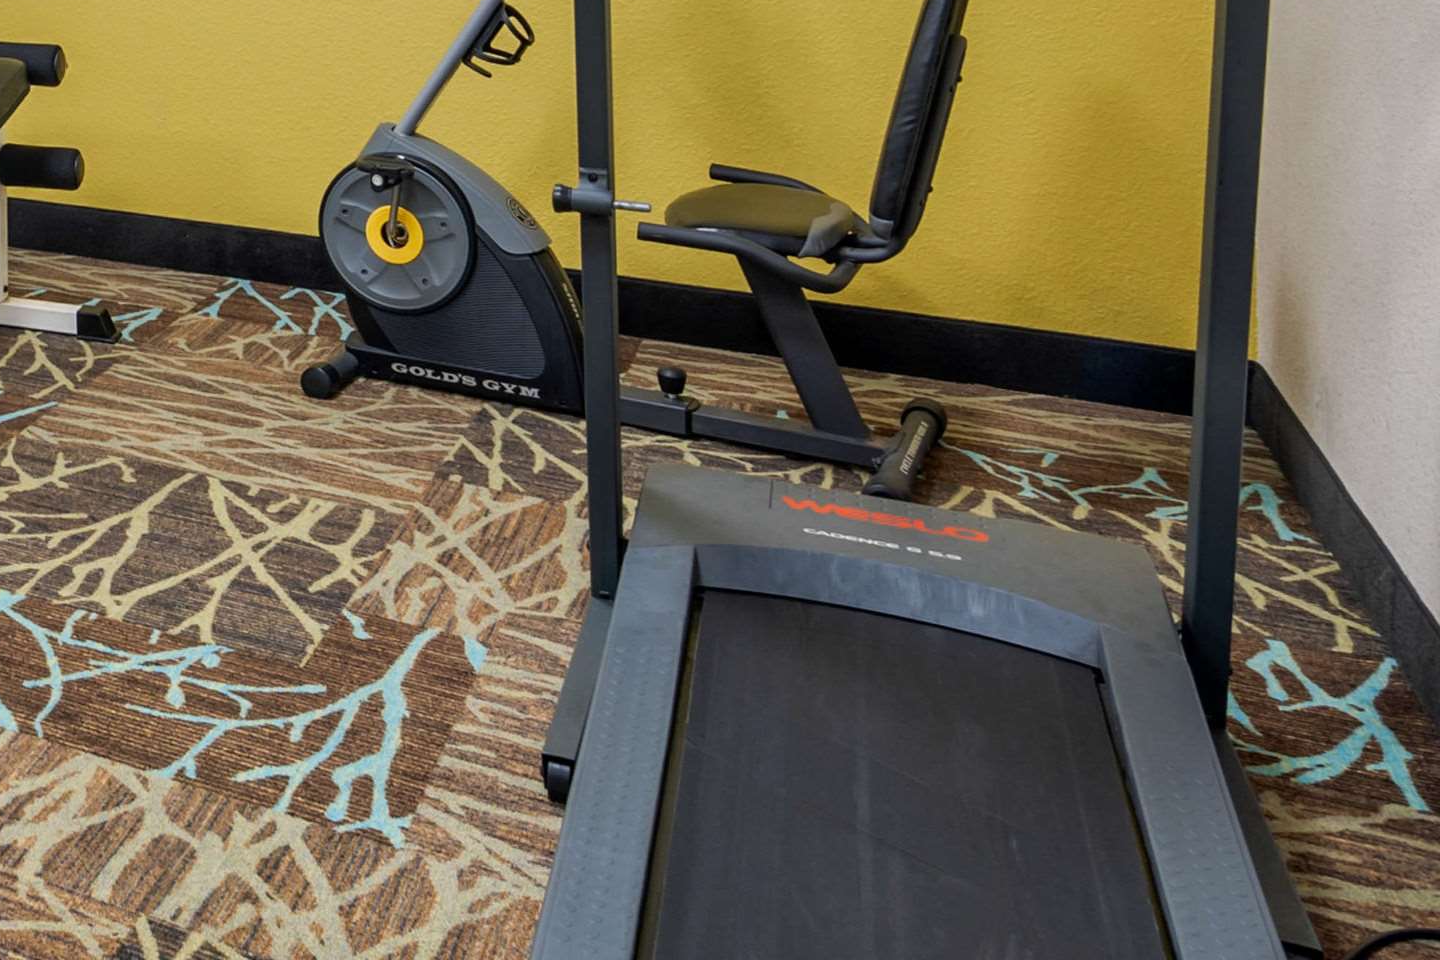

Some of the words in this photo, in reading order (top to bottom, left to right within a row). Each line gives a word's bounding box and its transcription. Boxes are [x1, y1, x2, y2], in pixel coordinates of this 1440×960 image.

[391, 362, 477, 387] GOLD'S
[482, 379, 541, 399] GYM
[803, 528, 900, 549] CADENCE
